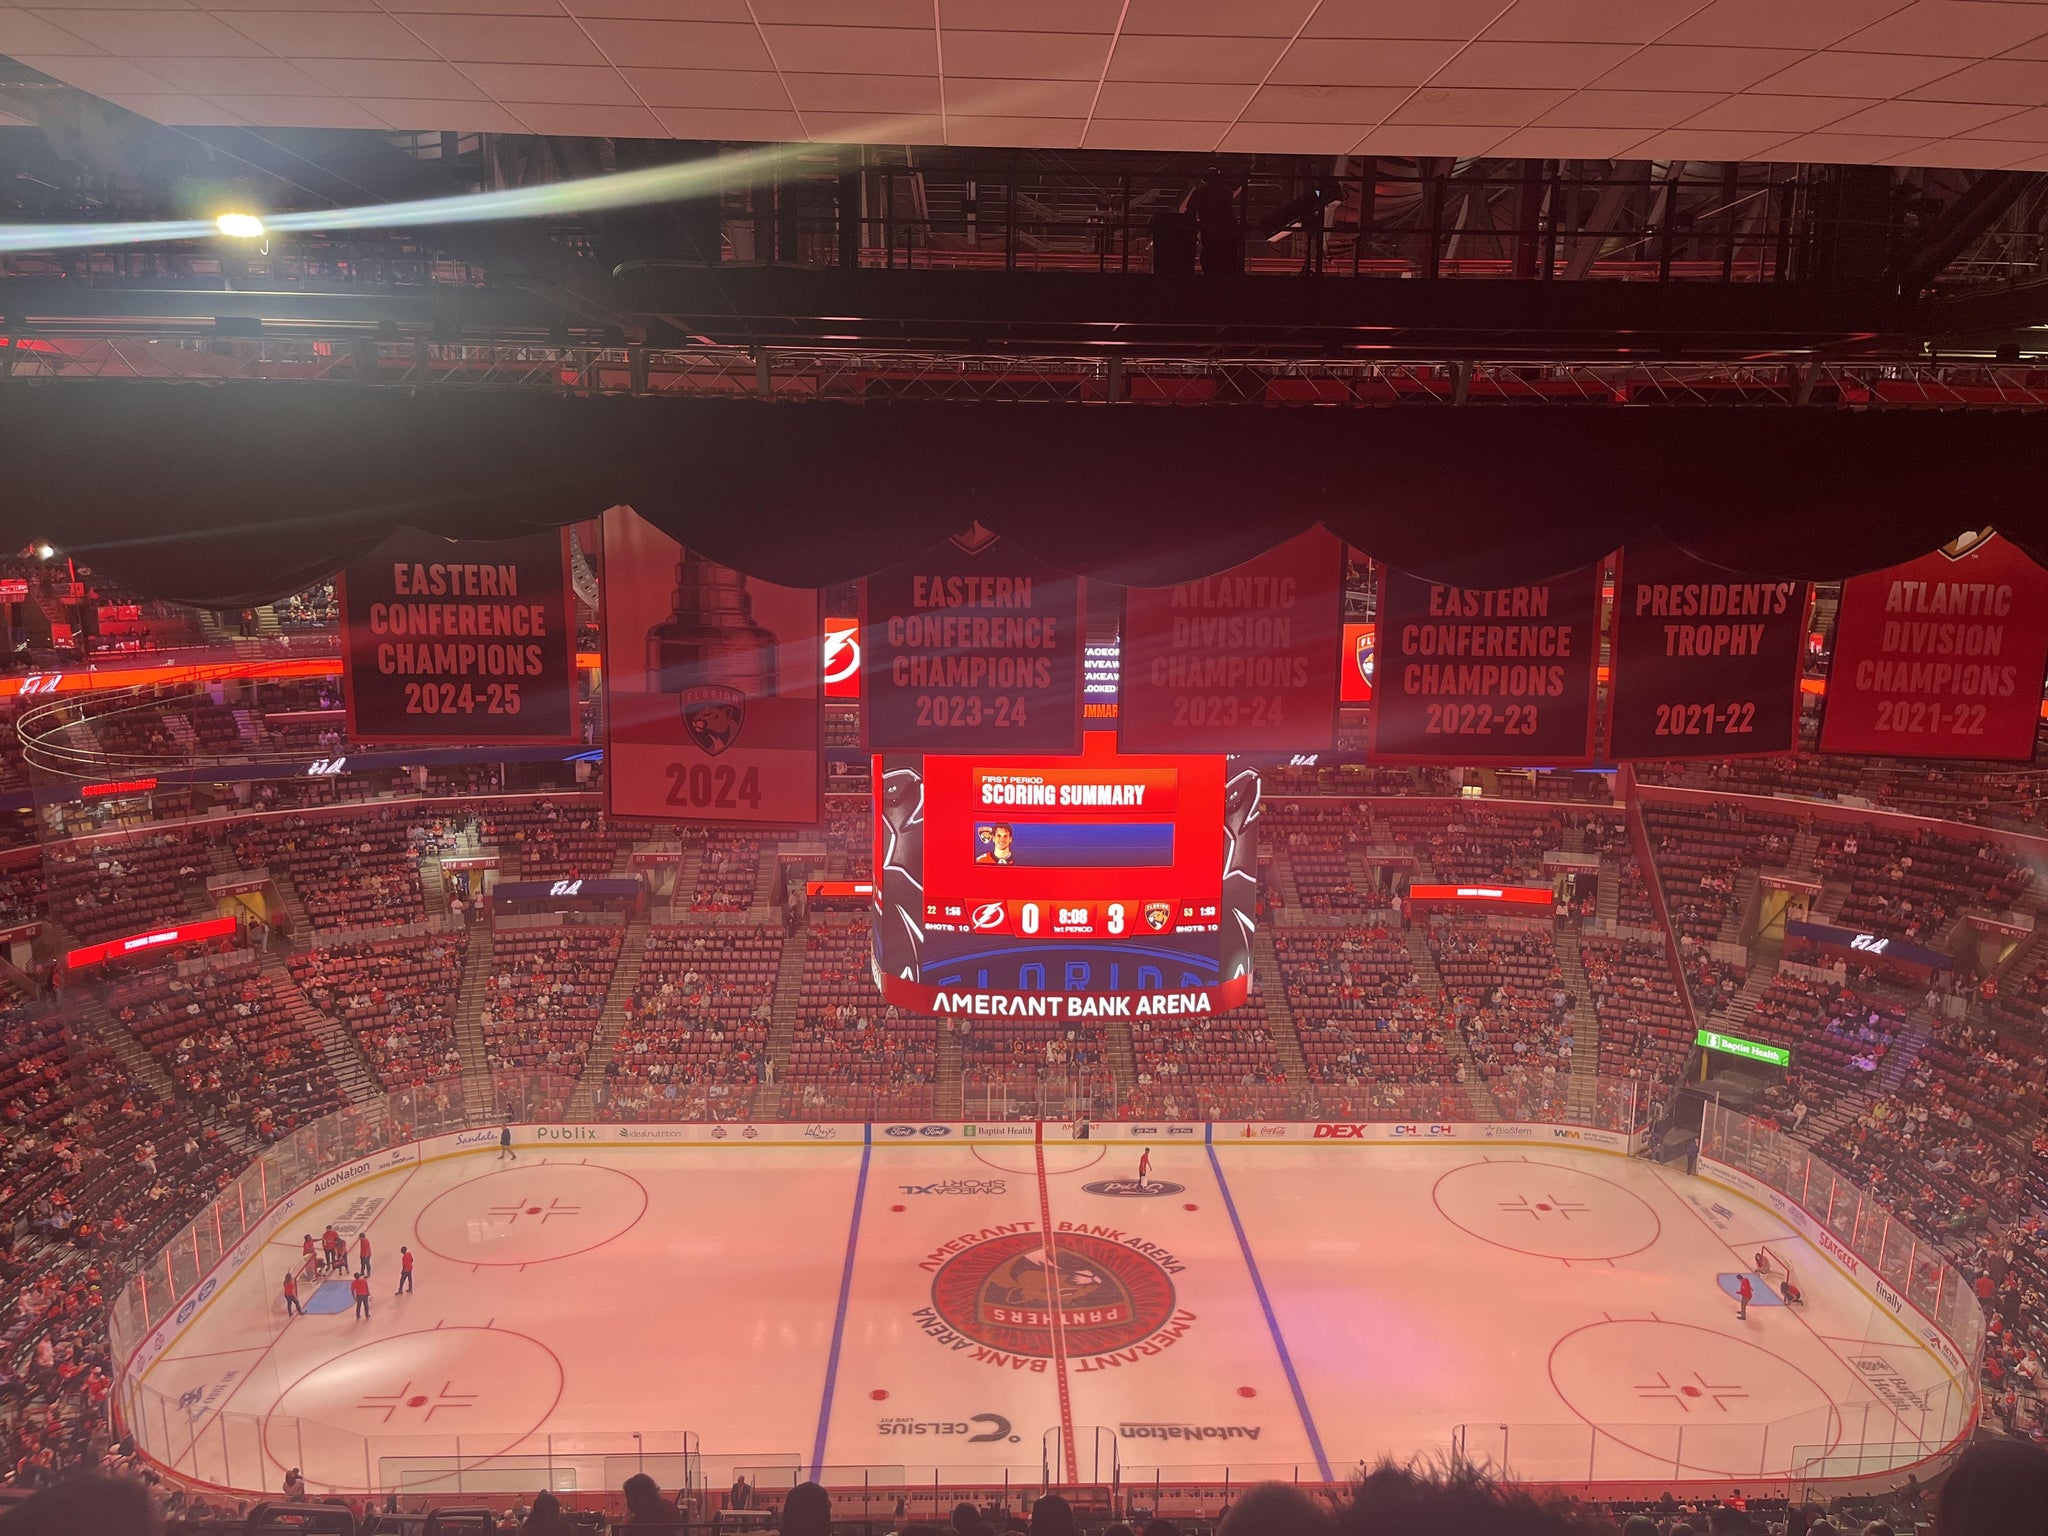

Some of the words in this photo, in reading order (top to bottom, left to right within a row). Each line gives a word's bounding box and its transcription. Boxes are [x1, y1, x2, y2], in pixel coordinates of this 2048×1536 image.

[395, 563, 517, 596] EASTERN
[914, 576, 1032, 608] EASTERN
[1171, 577, 1297, 609] ATLANTIC
[1429, 585, 1549, 618] EASTERN
[1636, 581, 1796, 617] PRESIDENTS'
[1885, 580, 2013, 617] ATLANTIC
[370, 603, 546, 636] CONFERENCE
[888, 616, 1056, 649] CONFERENCE
[1172, 616, 1291, 648] DIVISION
[1401, 624, 1570, 658] CONFERENCE
[1664, 624, 1764, 656] TROPHY
[1882, 621, 2003, 656] DIVISION
[378, 643, 543, 676] CHAMPIONS
[892, 656, 1051, 689] CHAMPIONS
[1151, 656, 1308, 688] CHAMPIONS
[1404, 663, 1564, 697] CHAMPIONS
[1856, 660, 2016, 697] CHAMPIONS
[405, 683, 521, 715] 2024-25
[687, 690, 738, 703] FLORIDA
[916, 697, 1027, 727] 2023-24
[1173, 697, 1283, 727] 2023-24
[1426, 703, 1538, 736] 2022-23
[1654, 703, 1756, 737] 2021-22
[1875, 701, 1987, 735] 2021-22
[665, 763, 761, 809] 2024
[982, 776, 1008, 784] FIRST
[1010, 776, 1043, 784] PERIOD
[982, 784, 1056, 805] SCORING
[1059, 785, 1145, 806] SUMMARY
[925, 922, 955, 932] SHOTS:
[1022, 903, 1039, 934] 0
[1107, 903, 1124, 934] 3
[1176, 924, 1205, 933] SHOTS:
[1207, 924, 1218, 932] 10
[932, 992, 1064, 1017] AMERANT
[1067, 995, 1131, 1017] BANK
[1135, 992, 1212, 1016] ARENA
[1721, 1040, 1750, 1054] Baptist
[1751, 1046, 1779, 1060] Health
[456, 1131, 497, 1145] Sandals
[537, 1126, 596, 1139] Publix
[891, 1126, 911, 1136] Ford
[925, 1126, 945, 1136] Ford
[978, 1125, 1005, 1136] Baptist
[1007, 1125, 1033, 1135] Health
[1313, 1124, 1367, 1138] DEX
[1395, 1125, 1417, 1134] CH
[1430, 1125, 1451, 1134] CH
[1496, 1126, 1532, 1135] BioStem
[1554, 1129, 1580, 1139] WM
[314, 1162, 370, 1195] AutoNation
[939, 1179, 1006, 1188] SPORT
[1104, 1181, 1164, 1195] Ford
[918, 1221, 1035, 1273] AMERANT
[1058, 1221, 1127, 1241] BANK
[1123, 1237, 1186, 1275] ARENA
[1819, 1231, 1859, 1275] SEATGEEK
[1876, 1281, 1902, 1313] finally
[912, 1307, 974, 1351] ARENA
[993, 1307, 1118, 1326] PANTHERS
[1075, 1309, 1197, 1373] AMERANT
[968, 1346, 1048, 1373] BANK
[1868, 1378, 1911, 1410] Health
[1888, 1378, 1933, 1411] Baptist
[879, 1422, 969, 1435] CELSIUS
[1119, 1425, 1261, 1441] AutoNation
